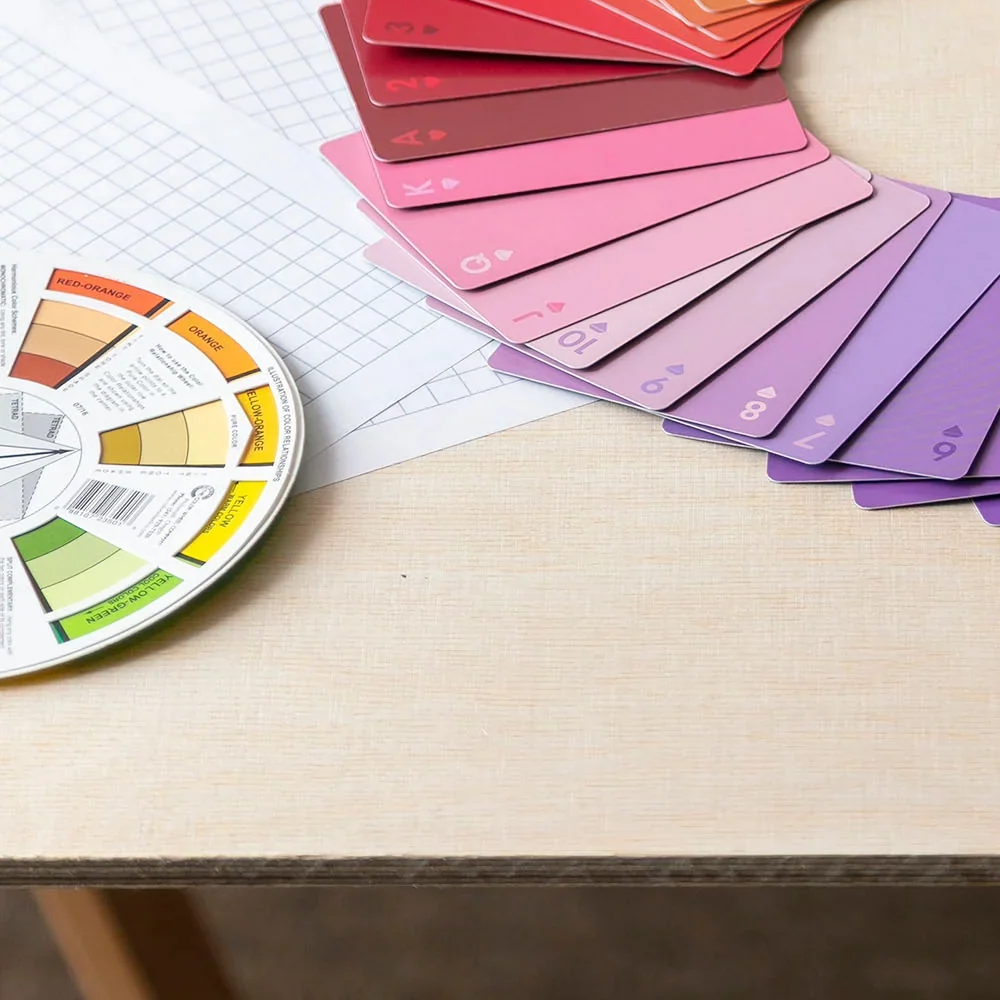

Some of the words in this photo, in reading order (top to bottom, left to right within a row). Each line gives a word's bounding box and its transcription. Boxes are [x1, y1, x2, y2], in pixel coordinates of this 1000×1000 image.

[384, 20, 415, 35] 3
[386, 77, 418, 93] 2
[390, 128, 424, 146] A
[402, 178, 436, 197] K
[460, 252, 492, 275] Q
[57, 278, 132, 301] RED-ORANGE
[512, 310, 543, 323] J
[188, 325, 223, 353] ORANGE
[557, 330, 598, 355] 10
[268, 366, 288, 406] ILLUSTRATION
[640, 376, 670, 395] 9
[11, 398, 19, 420] TETRAD
[283, 406, 289, 414] OF
[739, 400, 767, 421] 8
[47, 416, 58, 439] TETRAD
[247, 389, 263, 452] ELLOW-ORANGE
[793, 431, 827, 450] 7
[932, 440, 957, 462] 6
[272, 437, 291, 482] RELATIONSHIPS
[219, 494, 248, 528] YELLOW
[139, 573, 160, 587] COOL
[86, 574, 174, 625] YELLOW-GREEN
[107, 585, 139, 605] COLORS
